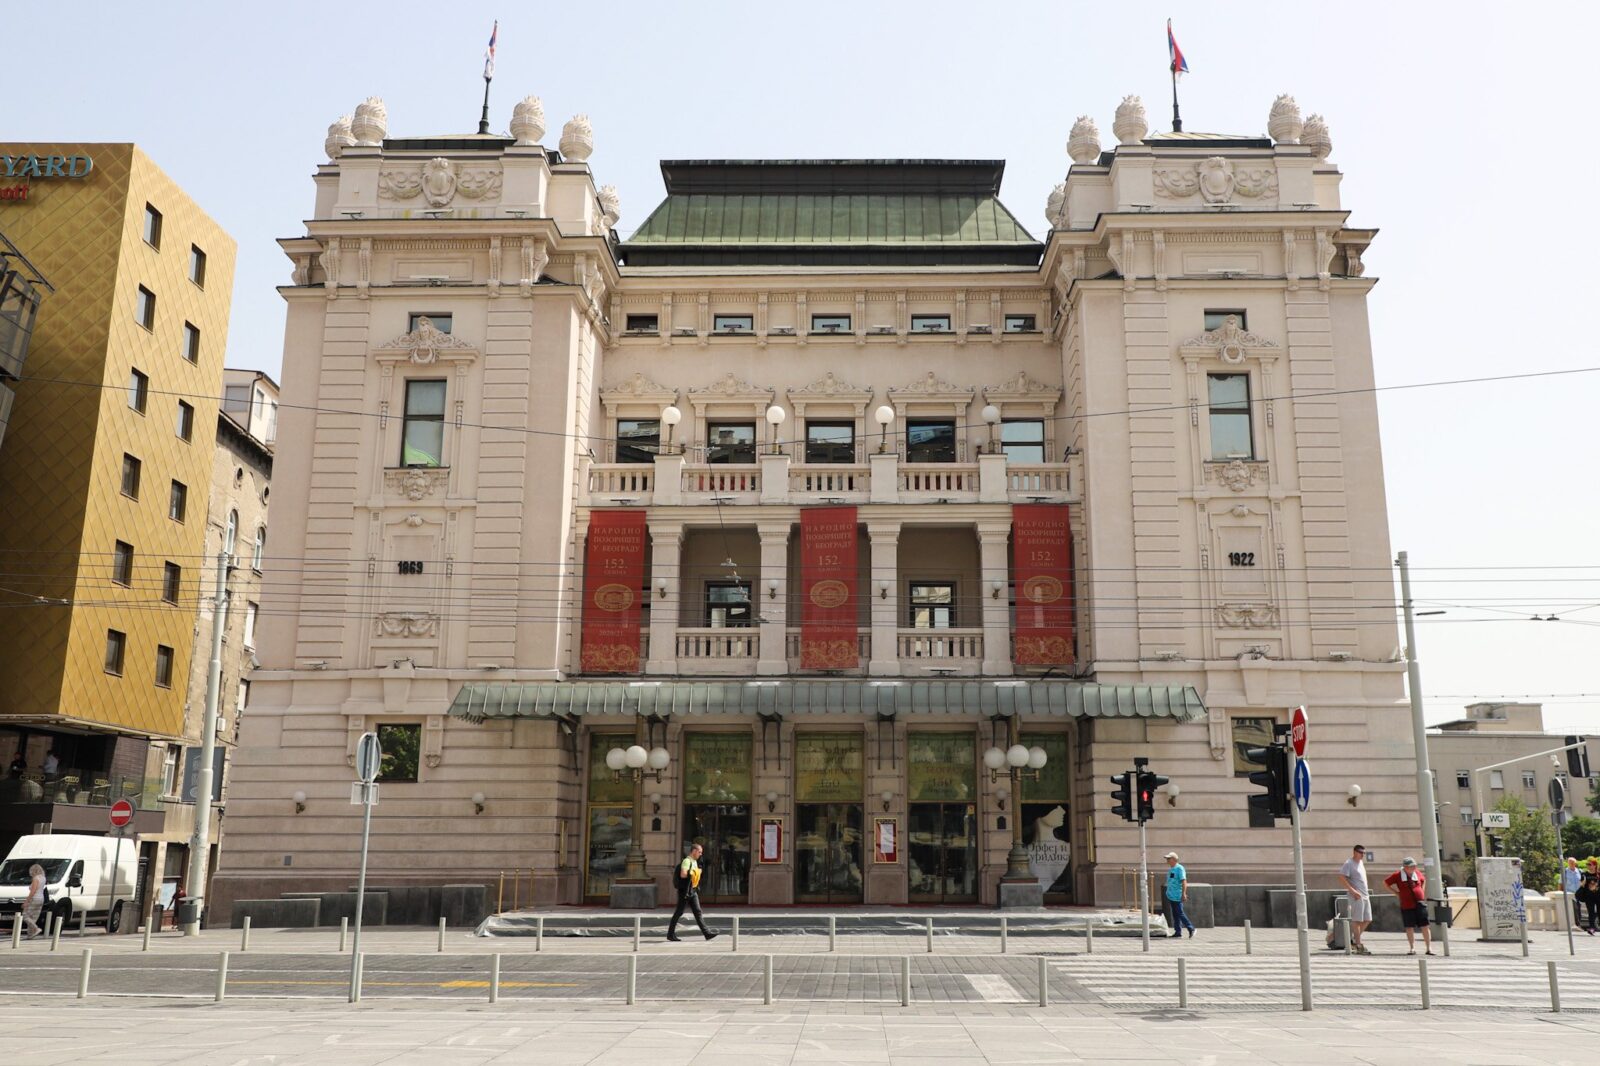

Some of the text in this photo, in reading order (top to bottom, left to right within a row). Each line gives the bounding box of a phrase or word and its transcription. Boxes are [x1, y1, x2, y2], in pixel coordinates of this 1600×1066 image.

[2, 154, 93, 177] YARD
[805, 523, 853, 532] НАРОДНО
[1018, 520, 1065, 528] НАРОДНО
[593, 527, 641, 535] НАРОДНО
[1018, 529, 1064, 537] ПОЗОРИШТЕ
[593, 536, 641, 544] ПОЗОРИШТЕ
[805, 532, 852, 541] ПОЗОРИШТЕ
[1027, 537, 1065, 545] БЕОГРАДУ
[602, 545, 640, 553] БЕОГРАДУ
[815, 541, 852, 550] БЕОГРАДУ
[818, 555, 841, 566] 152.
[1031, 551, 1055, 561] 152.
[1228, 552, 1255, 566] 1922
[397, 560, 423, 575] 1869
[604, 558, 629, 569] 152.
[1293, 723, 1304, 742] STOP
